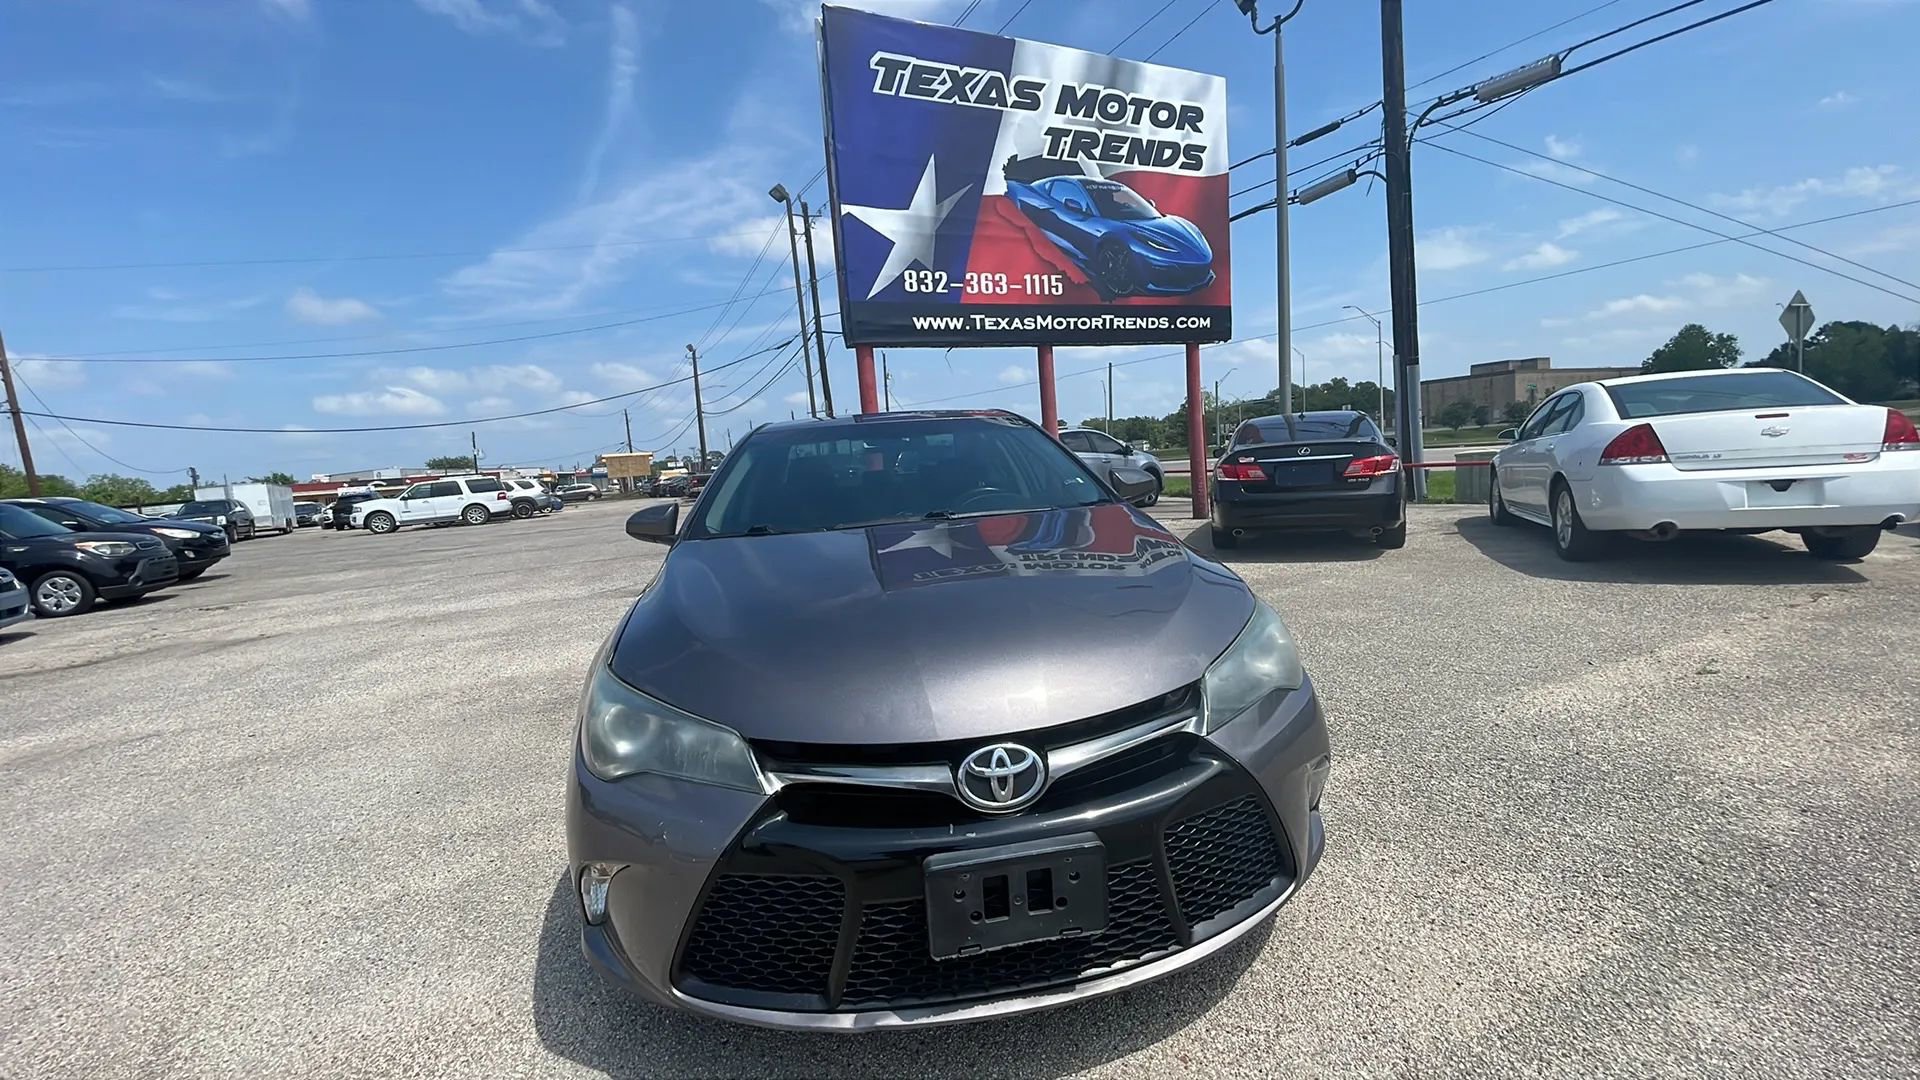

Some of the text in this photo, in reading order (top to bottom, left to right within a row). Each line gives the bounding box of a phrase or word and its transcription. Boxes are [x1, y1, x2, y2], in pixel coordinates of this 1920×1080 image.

[870, 52, 1205, 134] TEXAS MOTOR
[1043, 126, 1208, 172] TRENDS
[903, 269, 1064, 296] 832-363-1115
